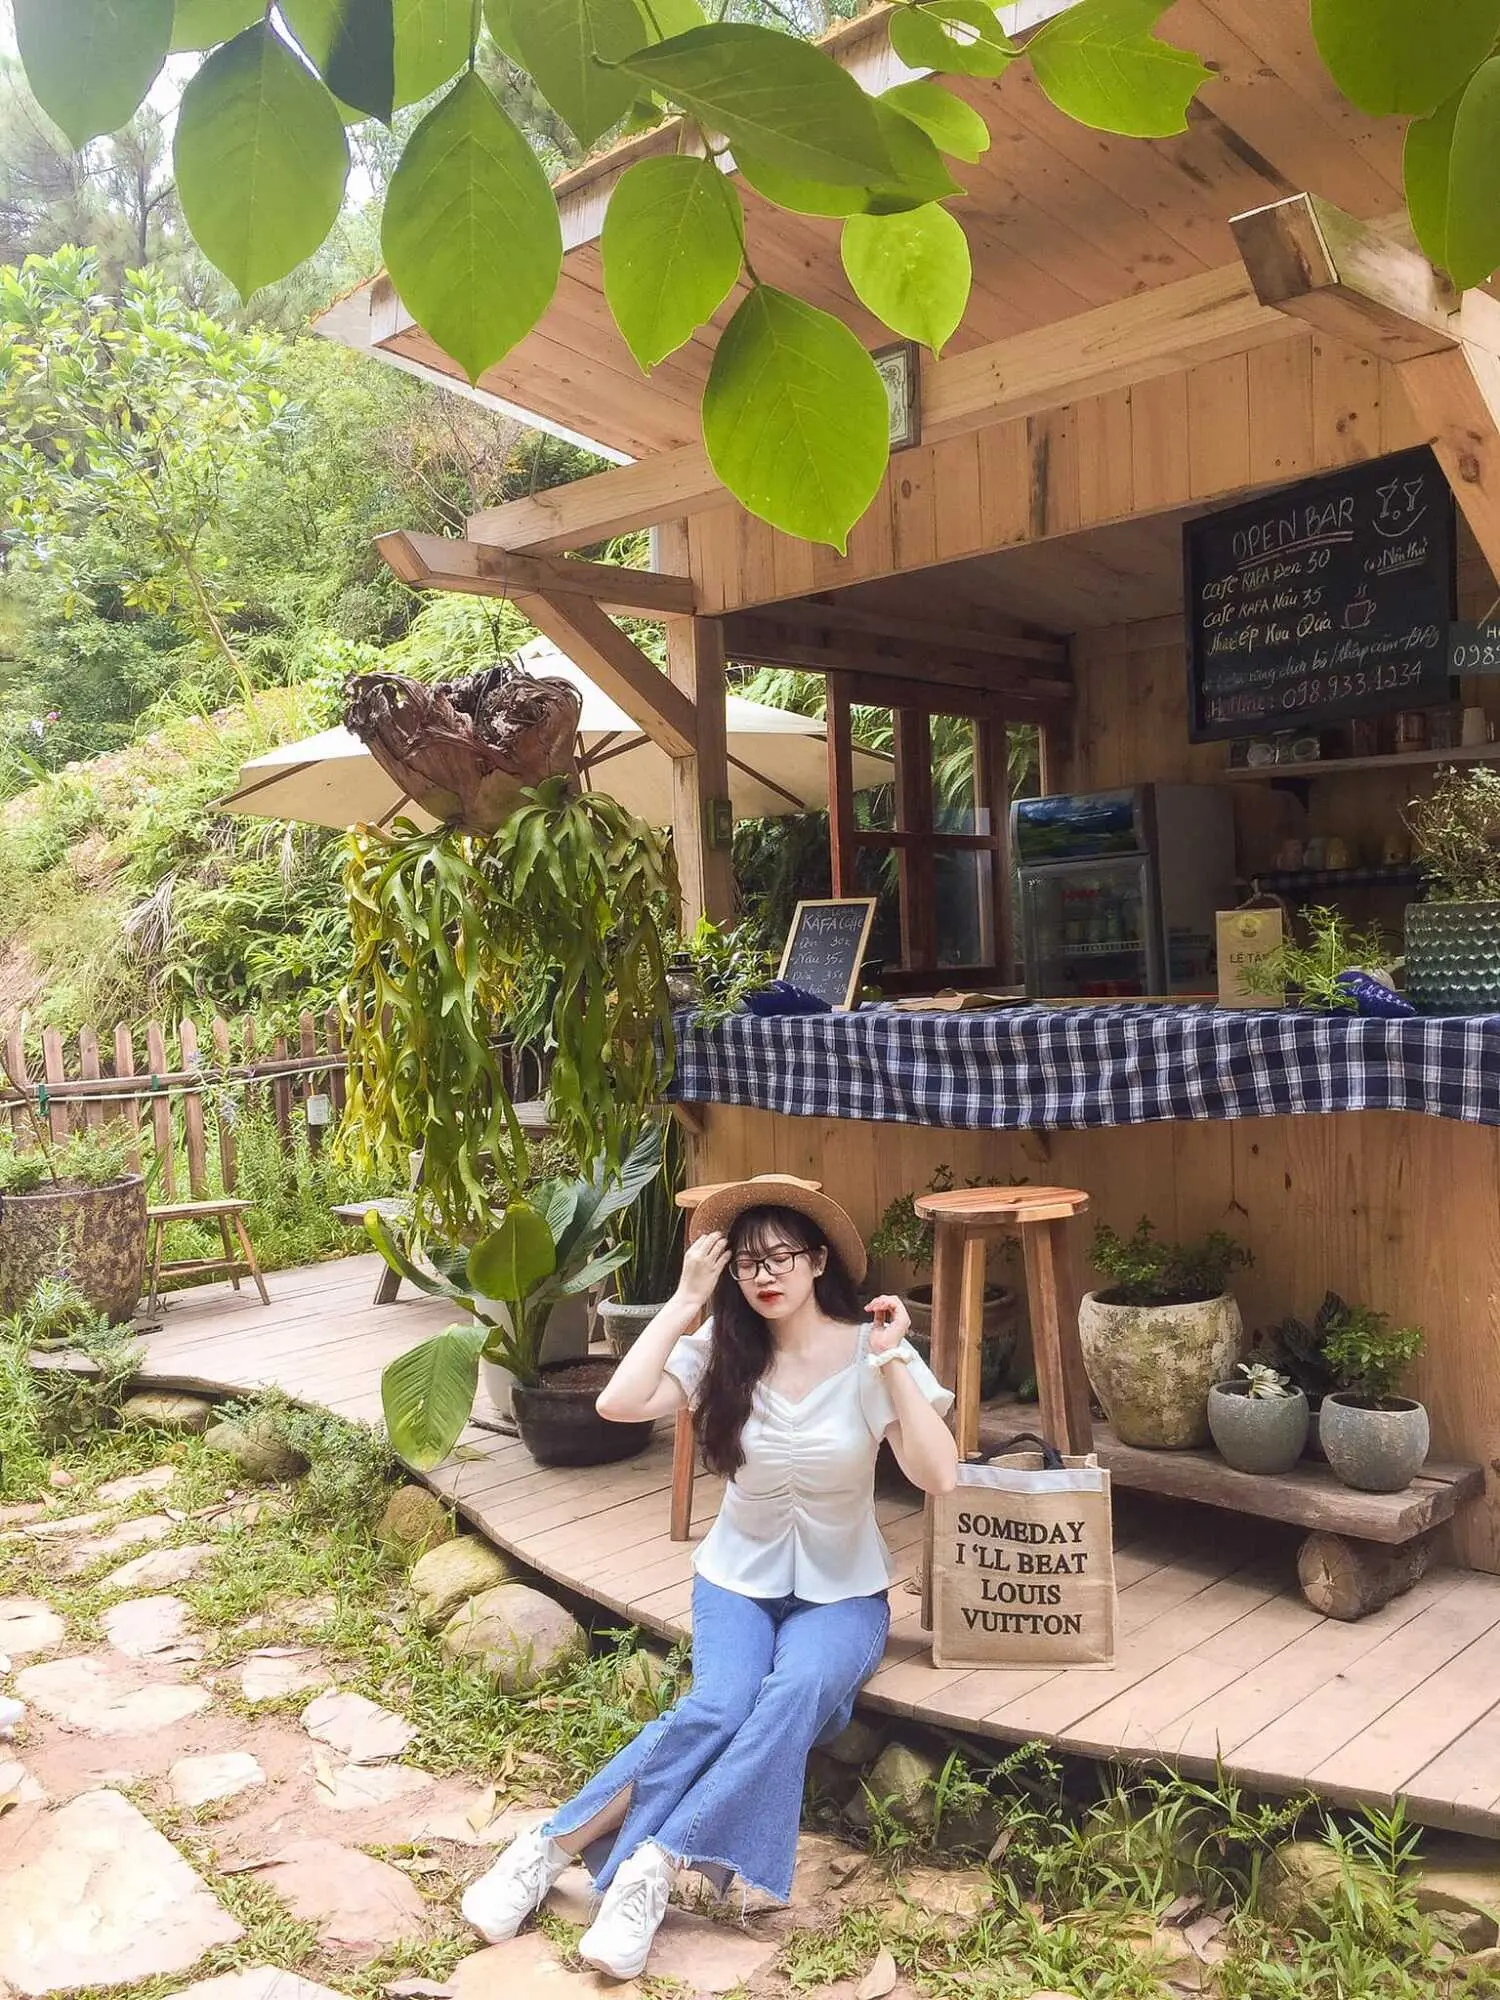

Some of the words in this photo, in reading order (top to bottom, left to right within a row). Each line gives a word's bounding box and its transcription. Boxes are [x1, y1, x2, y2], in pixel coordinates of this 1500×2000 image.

[1232, 509, 1296, 560] OPEN
[1305, 497, 1355, 537] BAR
[1238, 597, 1269, 618] KAFA
[1302, 585, 1328, 608] 35
[802, 913, 837, 936] KAFA
[957, 1512, 1086, 1545] SOMEDAY
[1017, 1552, 1088, 1575] BEAT
[981, 1579, 1062, 1605] LOUIS
[961, 1608, 1083, 1635] VUITTON
